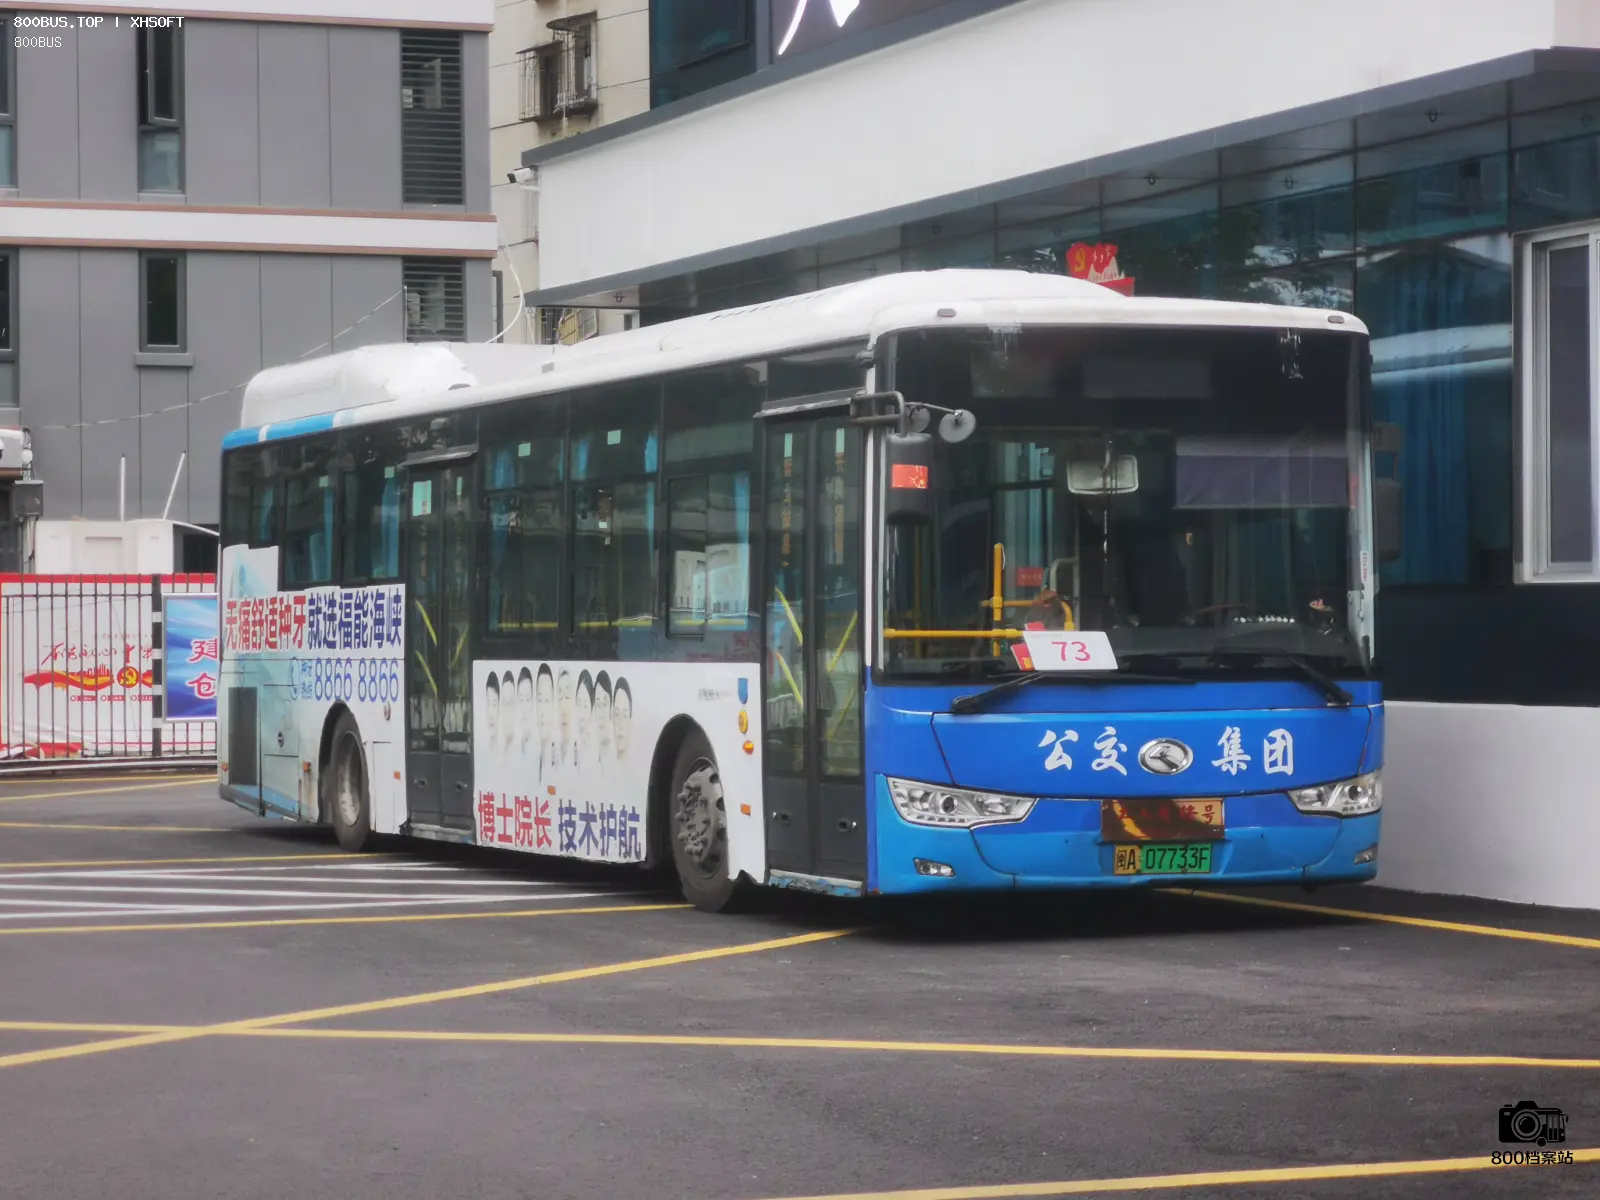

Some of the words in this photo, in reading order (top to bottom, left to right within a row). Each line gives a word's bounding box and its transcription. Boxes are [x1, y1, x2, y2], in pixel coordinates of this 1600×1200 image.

[225, 596, 306, 650] 无痛舒适种牙
[307, 588, 402, 650] 就选福能海峡
[1051, 641, 1091, 662] 73
[314, 657, 353, 701] 8866
[358, 657, 399, 702] 8866
[1037, 725, 1128, 776] 公交
[1211, 725, 1295, 776] 集团
[478, 791, 553, 849] 博士院长
[557, 798, 642, 860] 技术护航
[1145, 847, 1210, 870] 07733F
